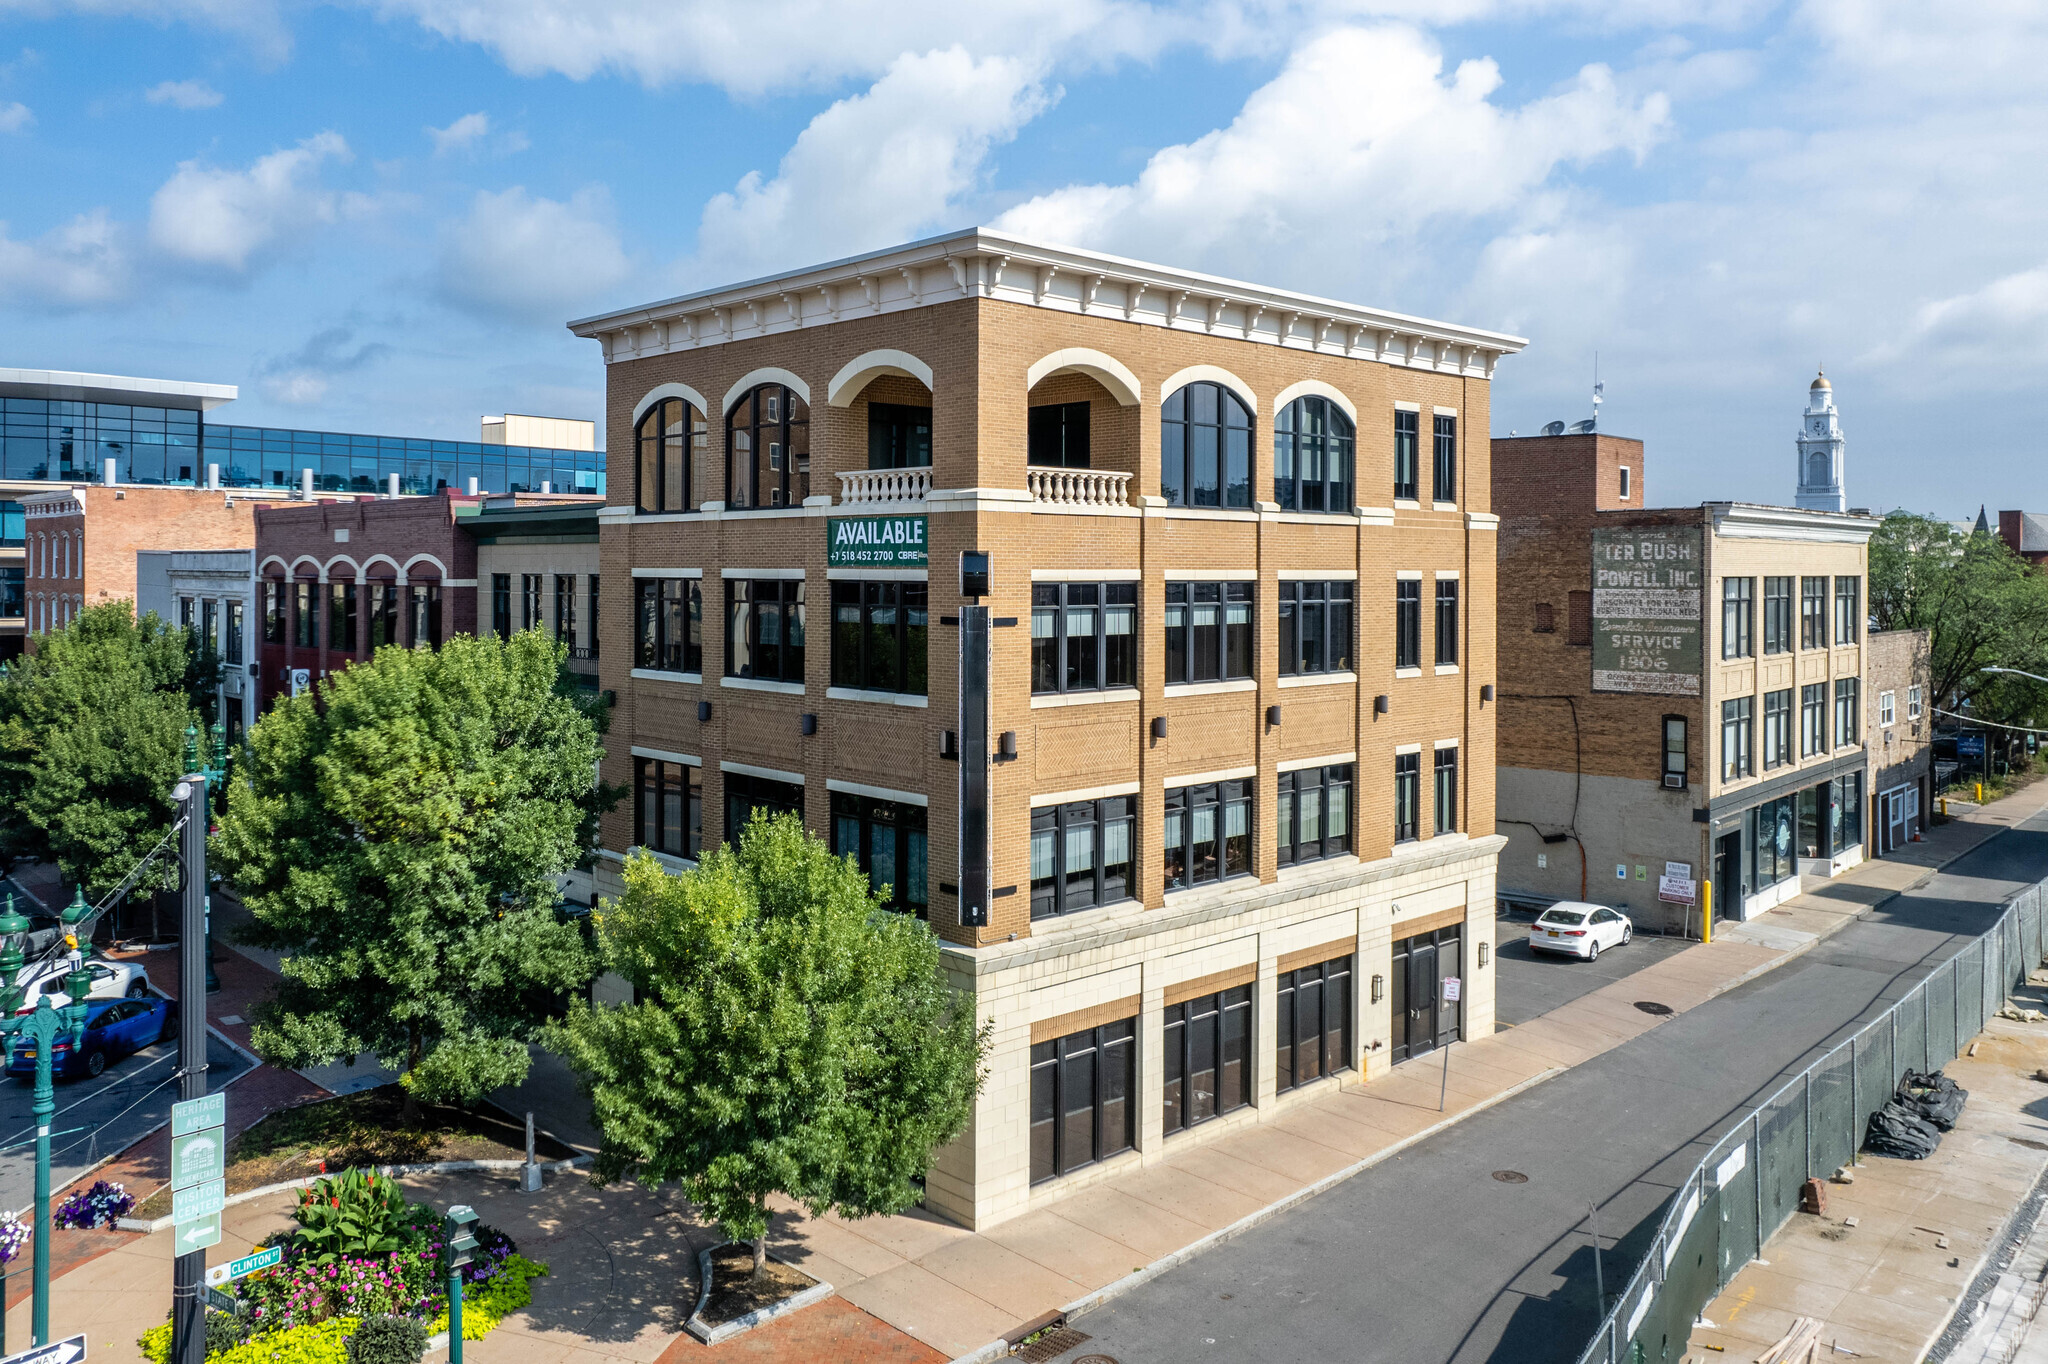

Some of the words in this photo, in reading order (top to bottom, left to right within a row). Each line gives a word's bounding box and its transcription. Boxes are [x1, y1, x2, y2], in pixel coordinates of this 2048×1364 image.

[835, 520, 923, 545] AVAILABLE
[830, 551, 839, 561] +1
[841, 551, 855, 561] 518
[856, 550, 872, 561] 452
[873, 550, 894, 561] 2700
[897, 551, 918, 560] CBRE
[1603, 542, 1635, 560] TER
[1641, 541, 1690, 560] BUSH
[1667, 568, 1698, 588] INC.
[1611, 634, 1682, 650] SERVICE
[1628, 648, 1662, 656] SINCE
[1661, 887, 1680, 895] PARKING
[175, 1099, 222, 1118] HERITAGE
[186, 1113, 212, 1129] AREA
[177, 1167, 219, 1187] SCHENECTADY
[176, 1184, 221, 1206] VISITOR
[177, 1197, 220, 1219] CENTER
[231, 1253, 271, 1275] CLINTON
[272, 1249, 279, 1257] ST
[210, 1290, 229, 1310] STATE
